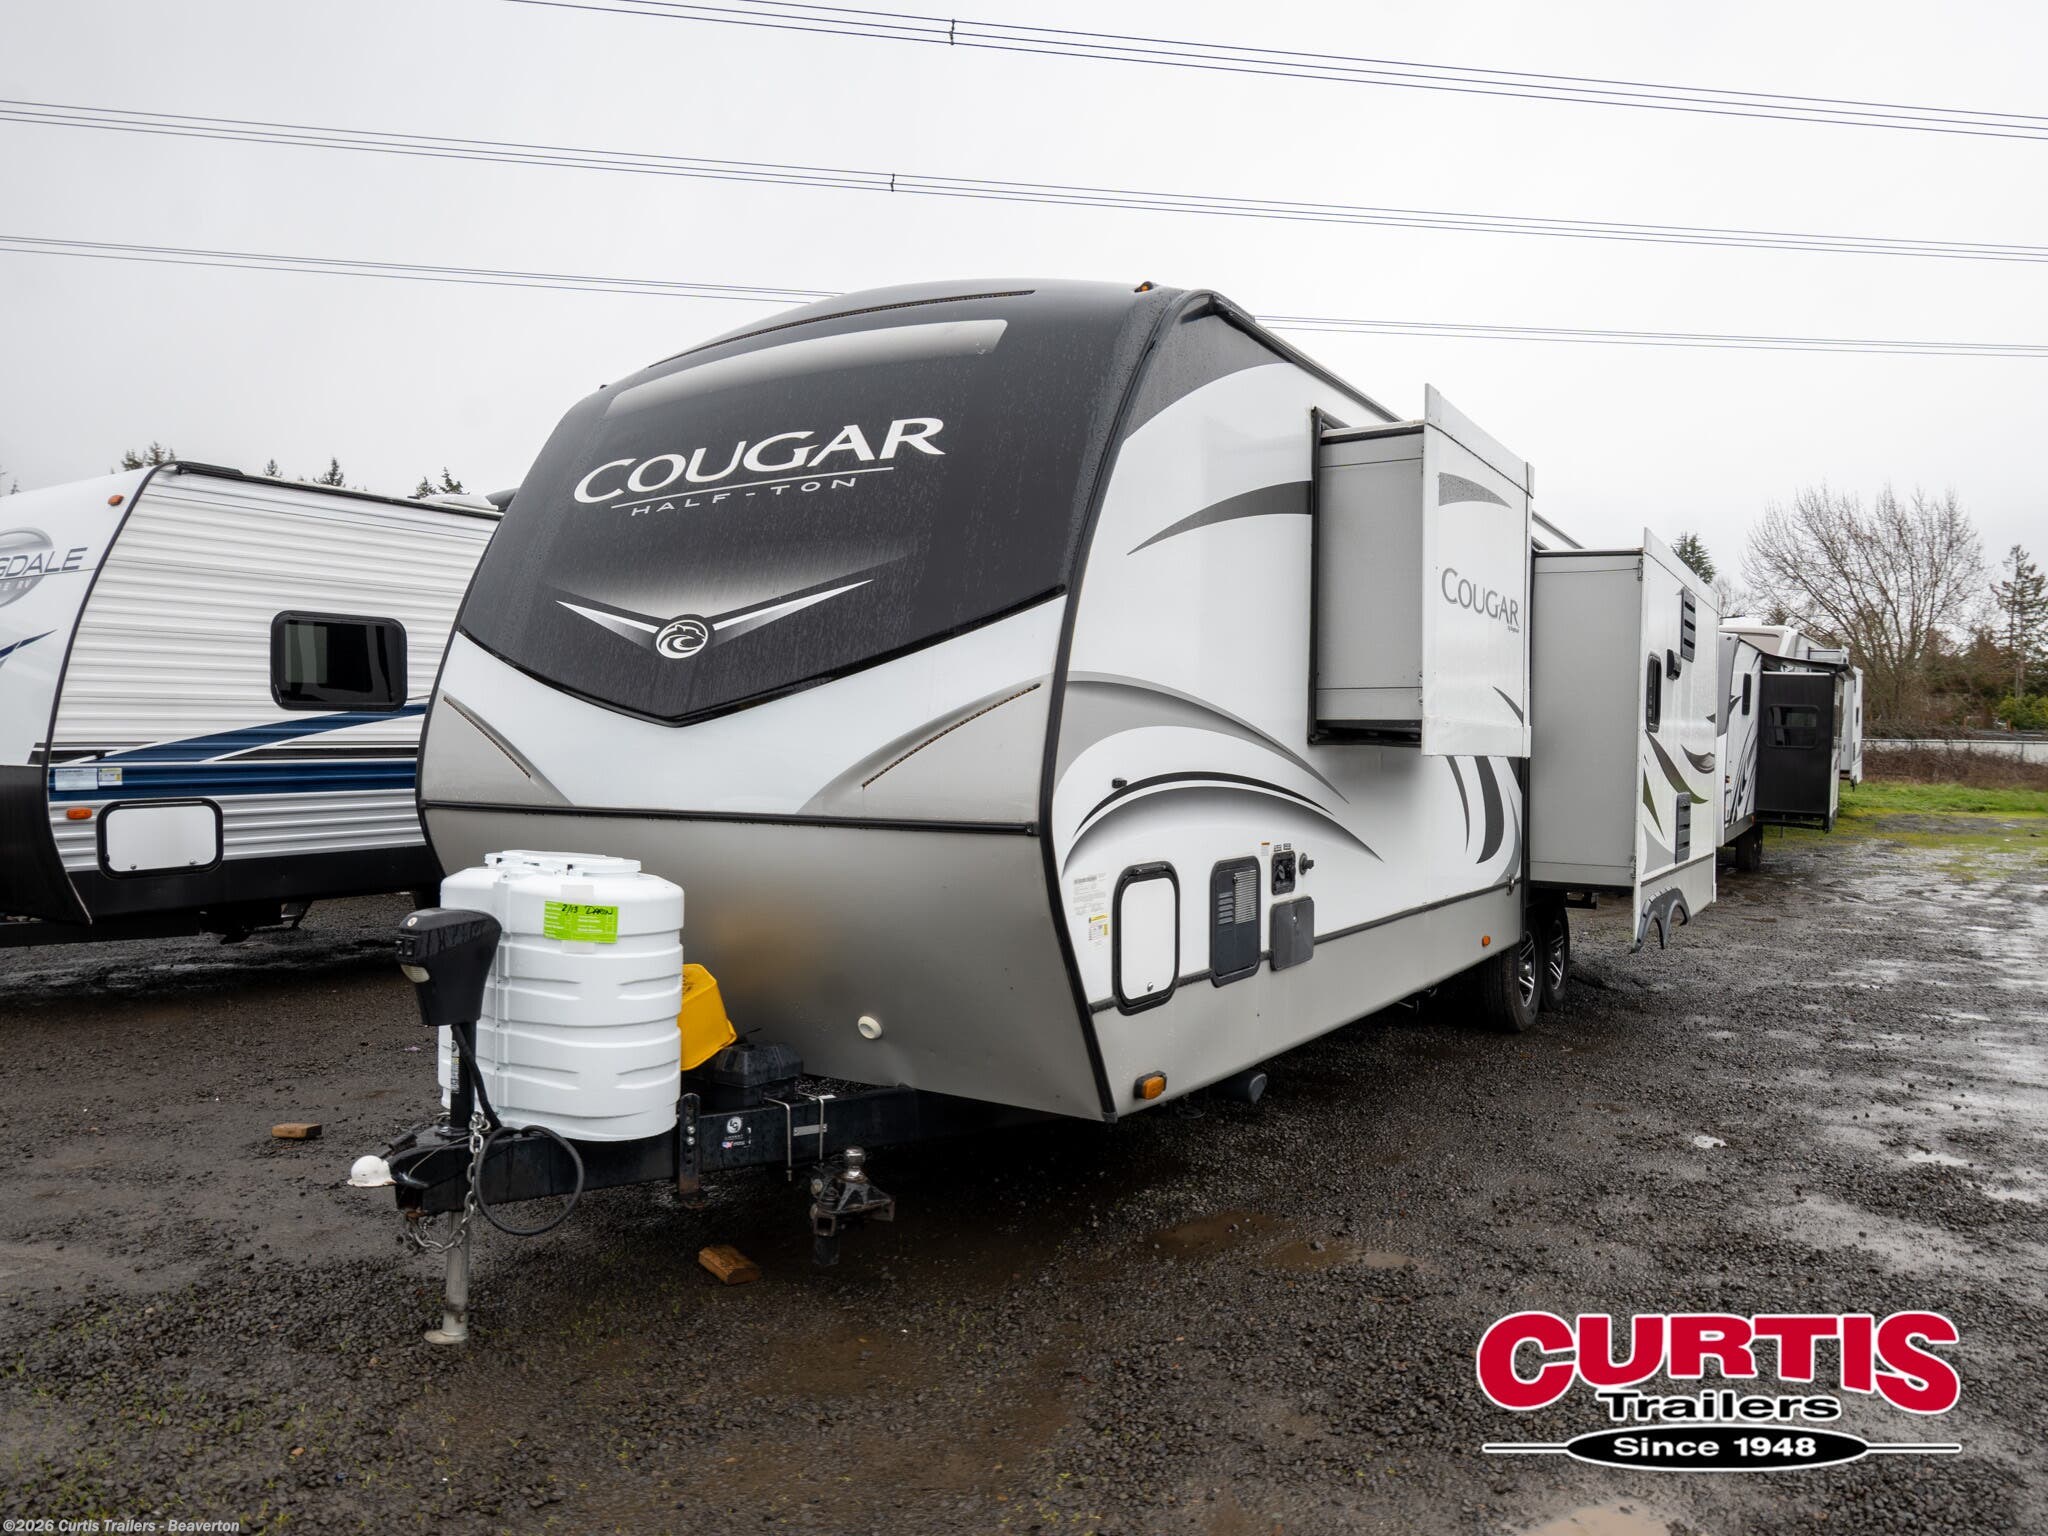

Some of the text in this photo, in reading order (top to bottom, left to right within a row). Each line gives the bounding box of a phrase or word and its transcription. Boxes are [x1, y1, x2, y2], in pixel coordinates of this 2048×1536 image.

[574, 417, 946, 504] COUGAR
[631, 477, 857, 517] HALF-TON
[1441, 567, 1520, 627] COUGAR
